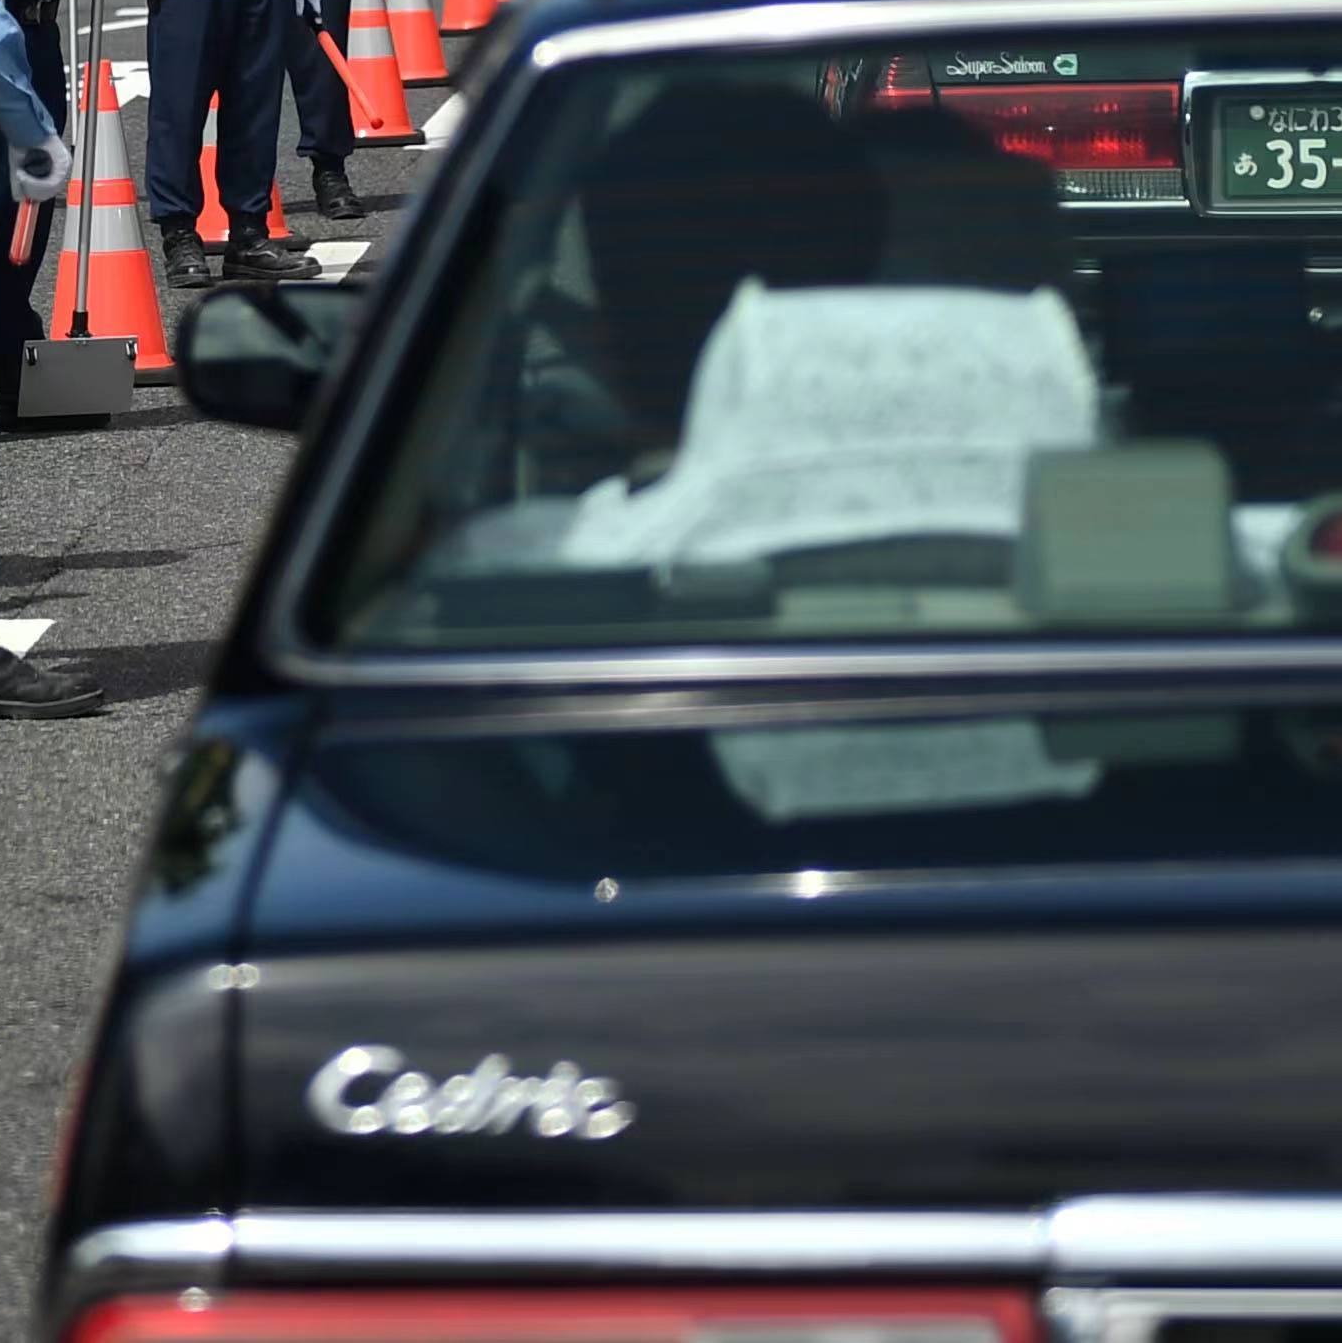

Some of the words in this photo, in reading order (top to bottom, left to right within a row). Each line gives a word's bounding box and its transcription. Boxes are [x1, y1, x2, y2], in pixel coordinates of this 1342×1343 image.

[946, 51, 994, 80] Super
[992, 51, 1048, 75] Saloon
[1233, 153, 1258, 176] あ
